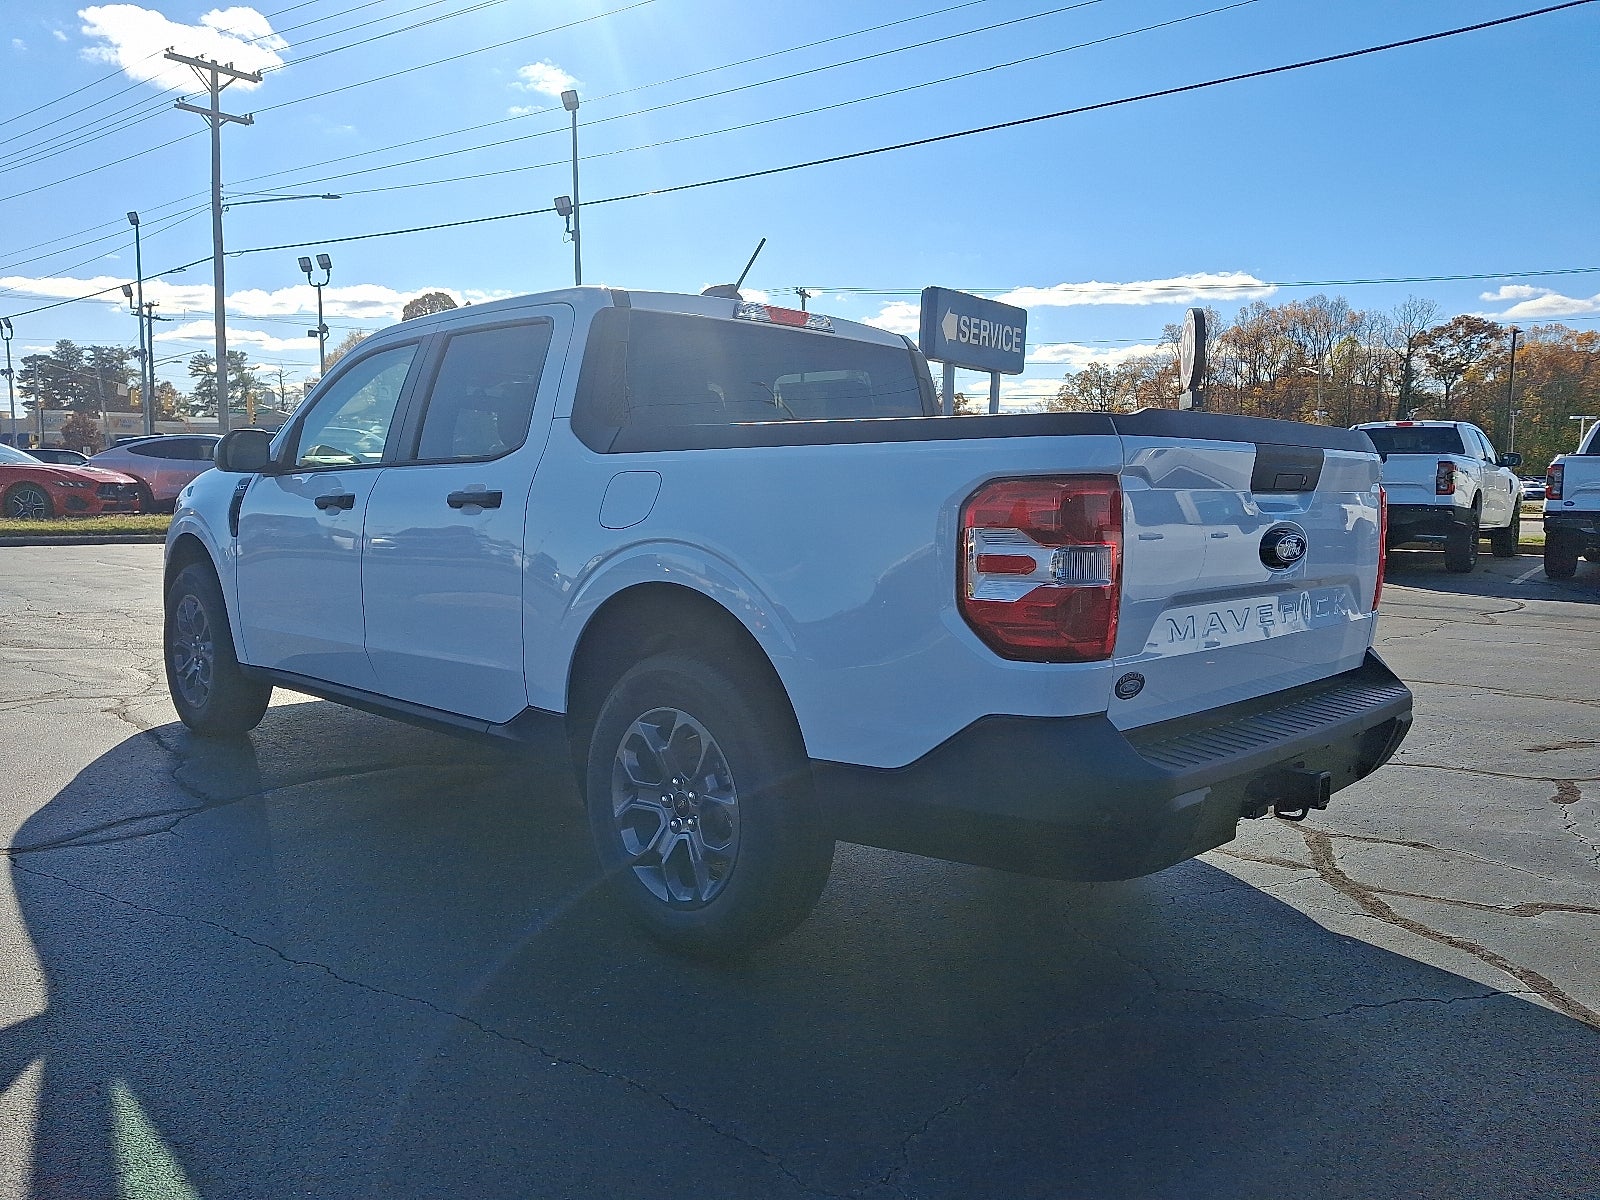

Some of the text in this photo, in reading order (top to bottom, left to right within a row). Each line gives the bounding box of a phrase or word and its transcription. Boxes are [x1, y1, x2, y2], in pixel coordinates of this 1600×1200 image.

[959, 315, 1022, 353] SERVICE
[1281, 538, 1303, 557] Ford
[1166, 591, 1347, 643] MAVERICK
